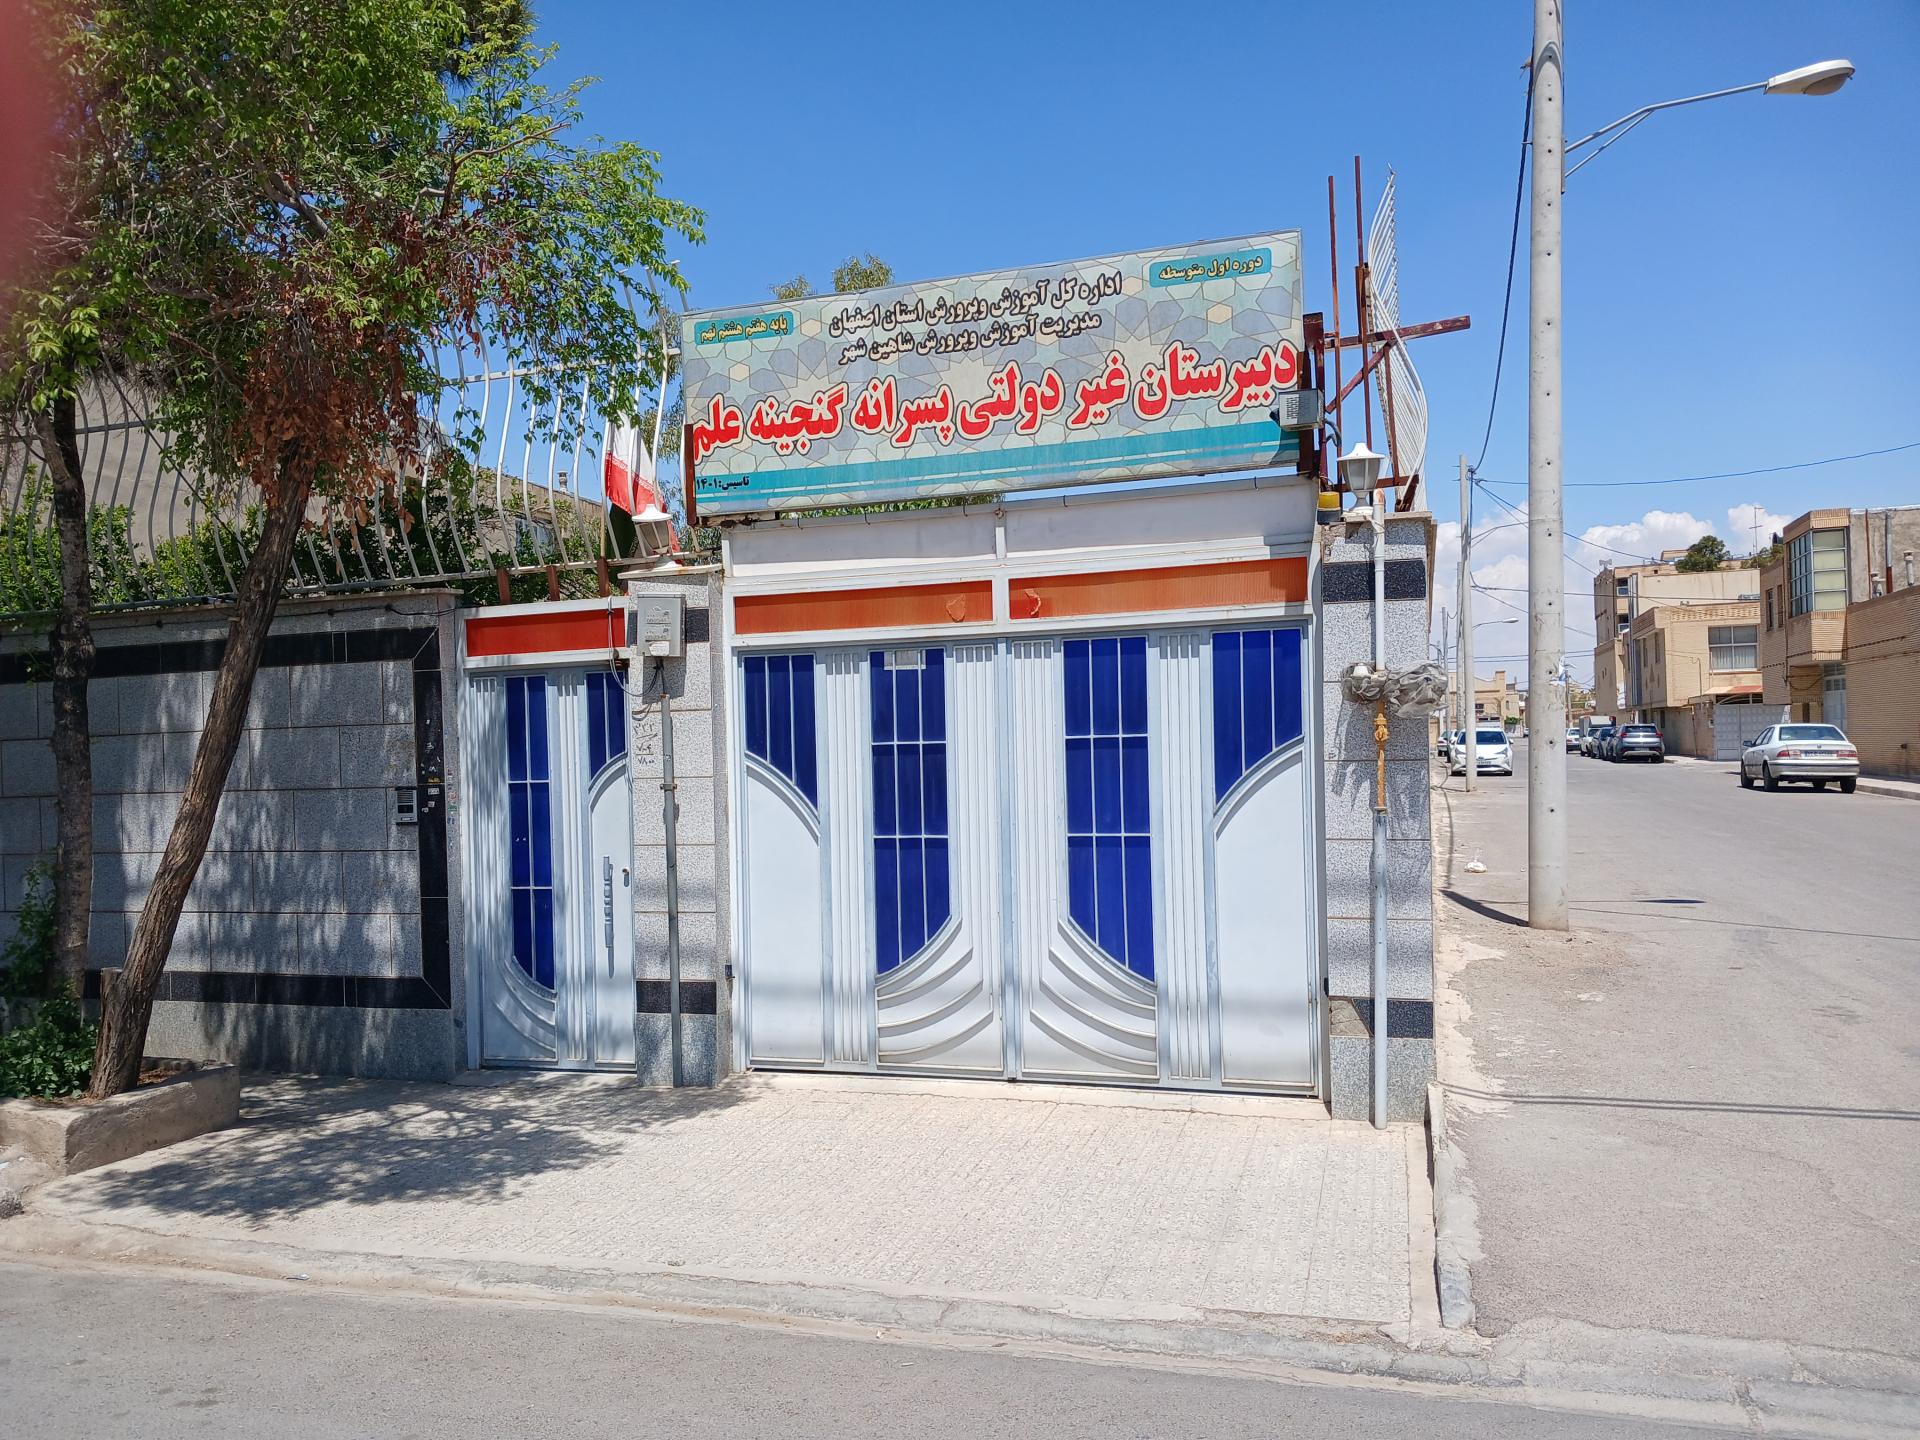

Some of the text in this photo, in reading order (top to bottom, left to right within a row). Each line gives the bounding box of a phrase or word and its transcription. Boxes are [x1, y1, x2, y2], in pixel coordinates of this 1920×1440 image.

[1158, 255, 1263, 282] دوره اول متوسطه
[989, 279, 1050, 316] آموزش
[1051, 278, 1077, 309] کل
[1078, 271, 1123, 306] اداره
[700, 313, 789, 344] پایه هفتم هشتم نهم
[829, 305, 881, 338] اصفهان
[881, 298, 925, 331] استان
[979, 314, 1038, 346] آموزش
[1040, 311, 1102, 340] مدیریت
[838, 340, 867, 365] شهر
[868, 332, 915, 361] شاهین
[692, 343, 1298, 462] دبیرستان غیر دولتی پسرانه گنجینه علم
